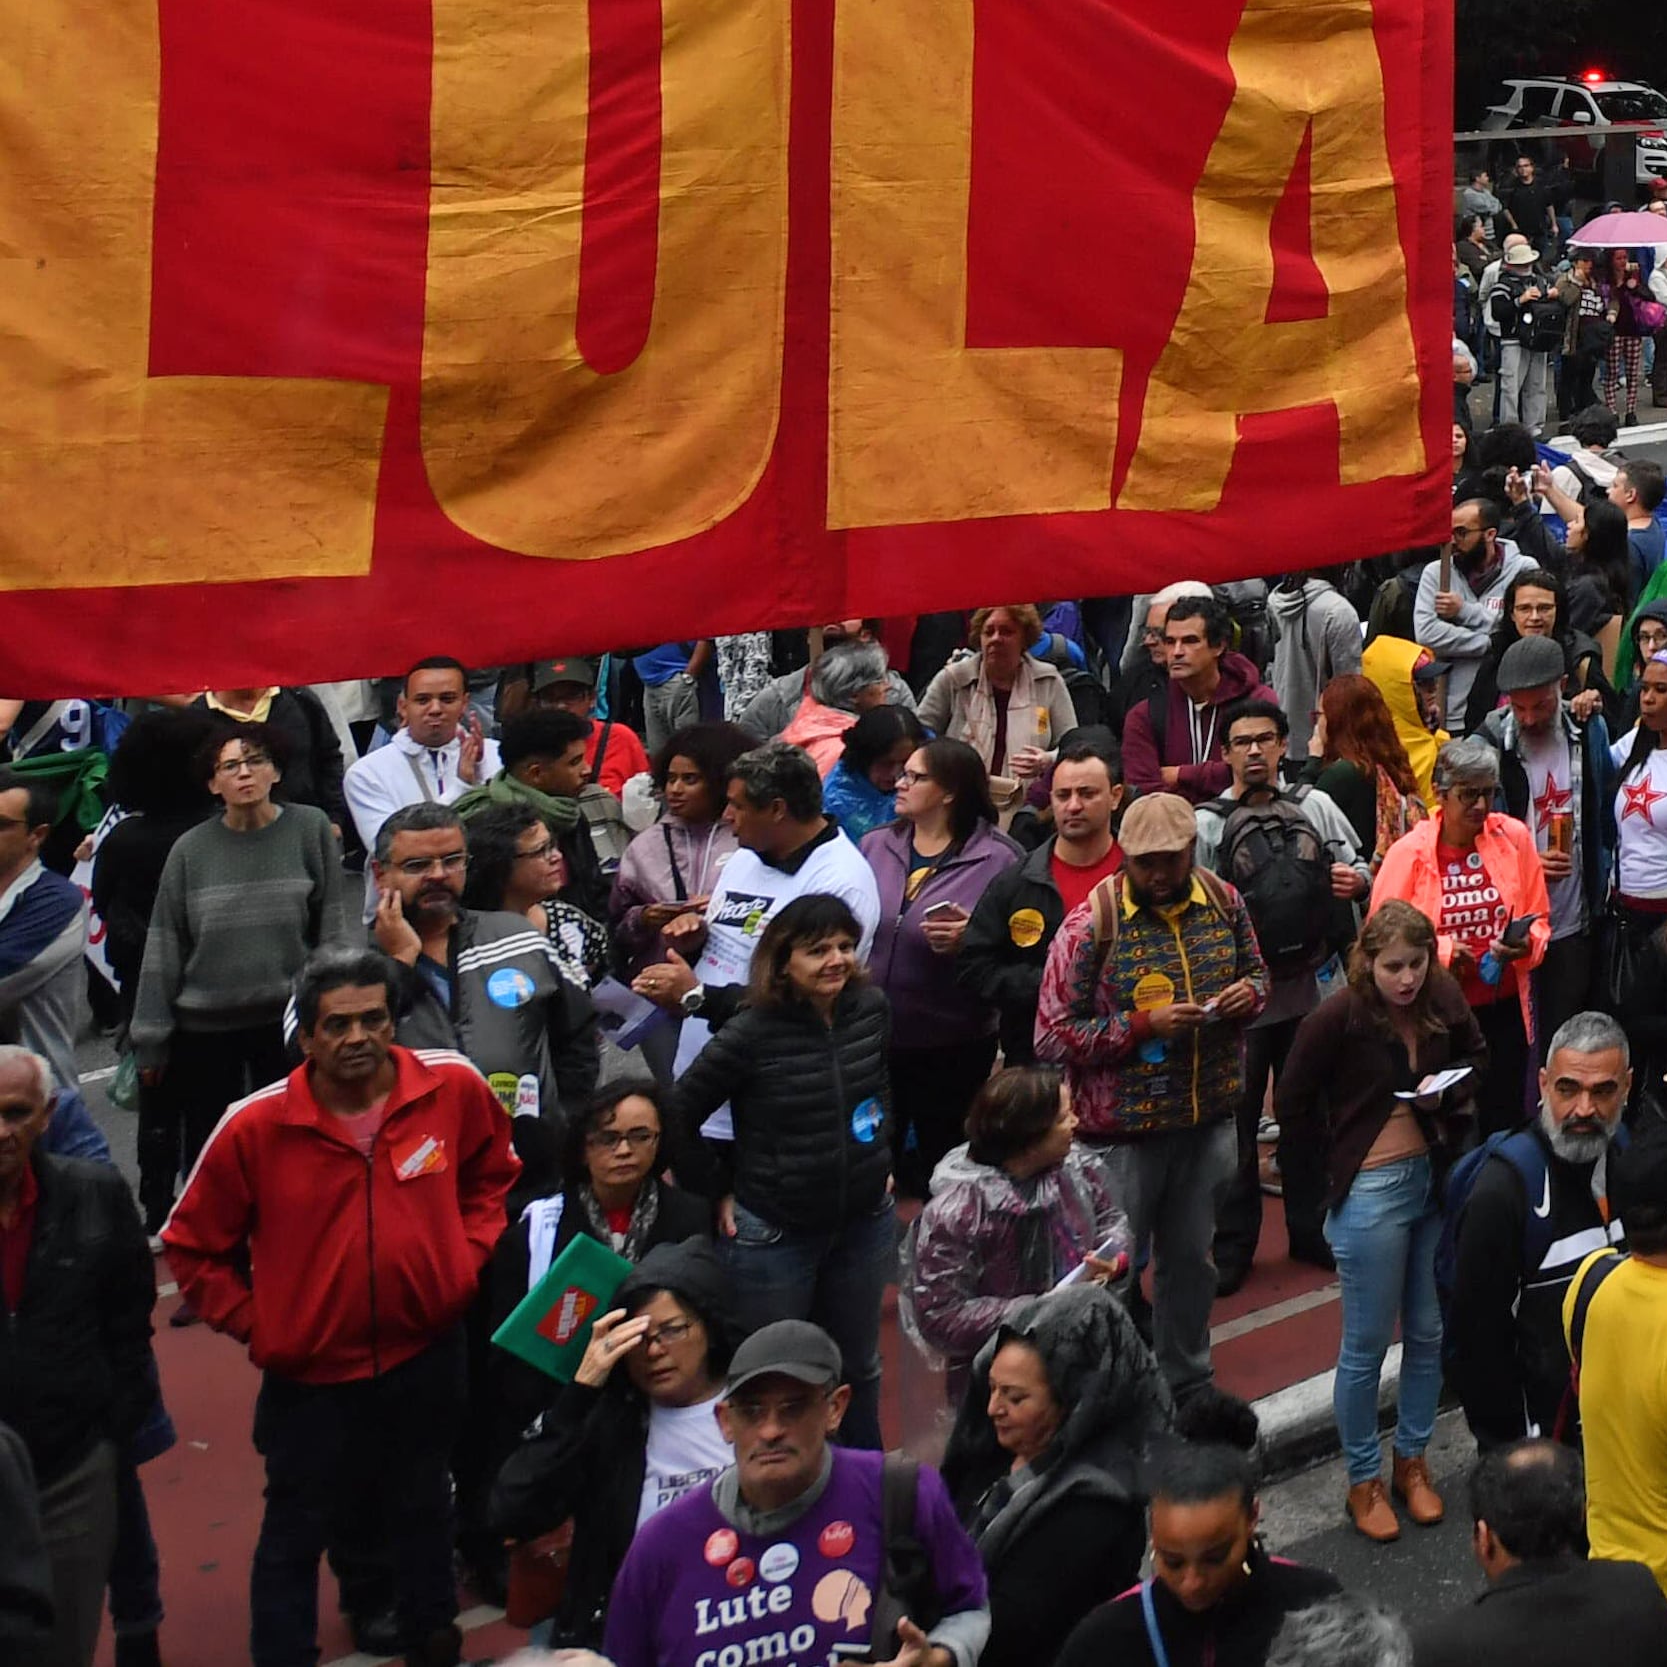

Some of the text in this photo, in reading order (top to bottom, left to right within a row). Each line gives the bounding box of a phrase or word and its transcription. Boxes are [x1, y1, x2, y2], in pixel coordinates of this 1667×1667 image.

[1442, 872, 1484, 890] ute
[1442, 887, 1499, 908] omo
[695, 1584, 793, 1634] Lute
[692, 1623, 817, 1667] como
